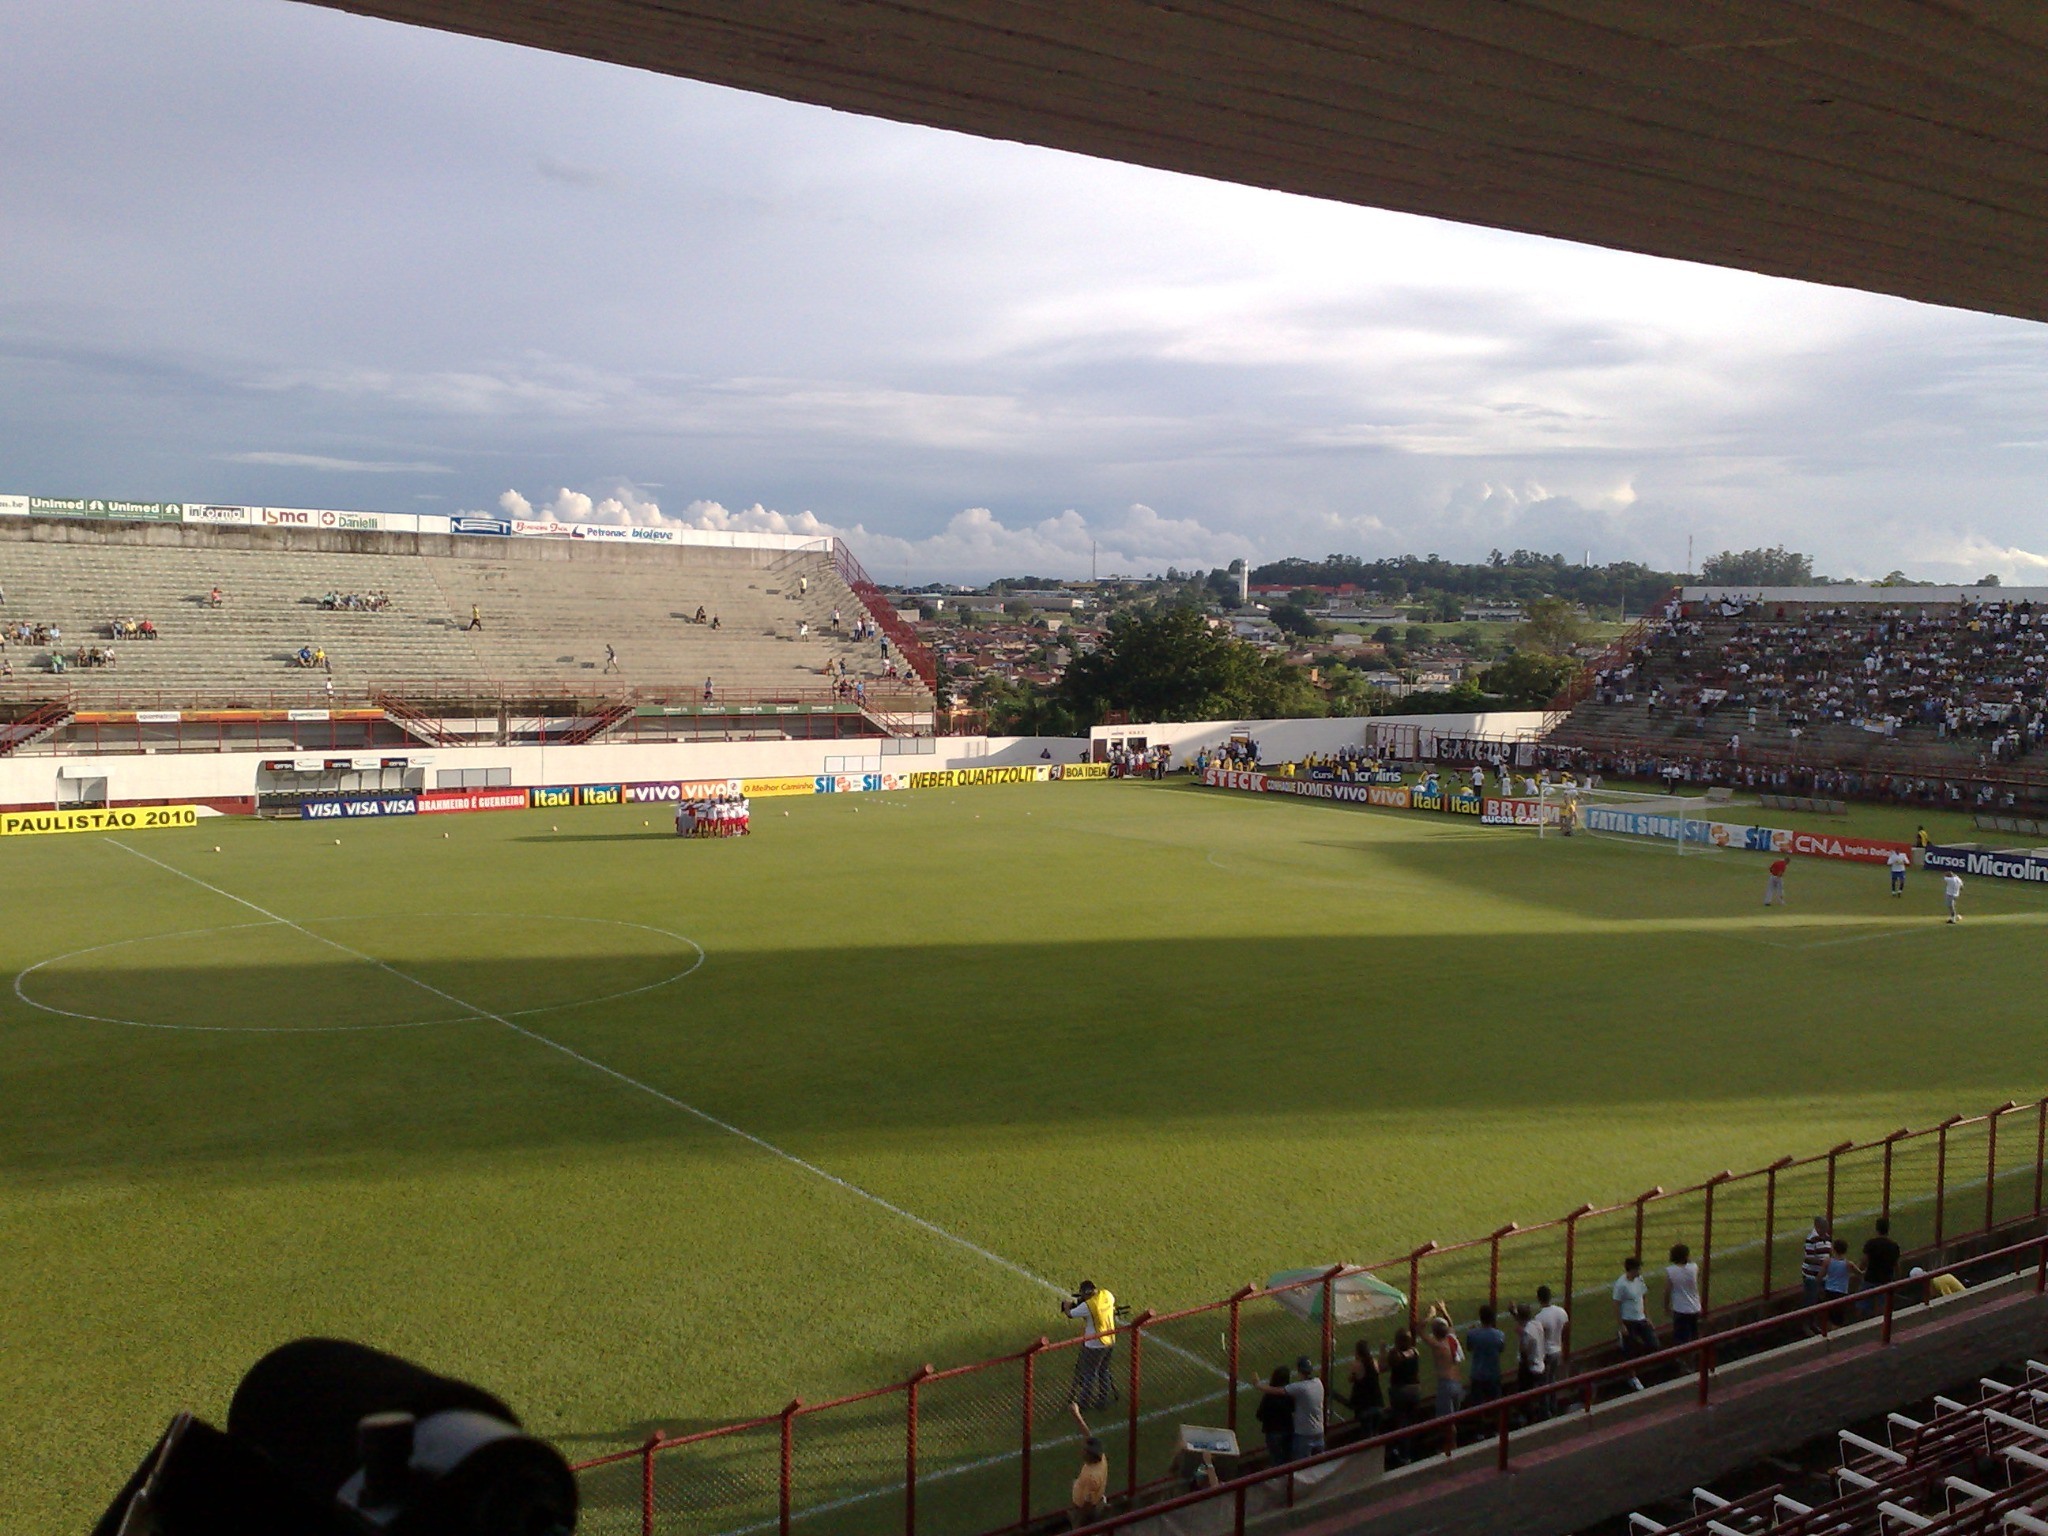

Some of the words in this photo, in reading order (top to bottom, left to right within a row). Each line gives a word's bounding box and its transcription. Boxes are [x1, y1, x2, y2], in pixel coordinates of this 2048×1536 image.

[31, 498, 84, 510] Unimed
[108, 501, 160, 513] Unimed
[909, 770, 954, 789] WEBER
[957, 766, 1037, 786] QUARTZOLIT
[1066, 767, 1084, 778] BOA
[1206, 770, 1263, 791] STECK
[781, 782, 814, 790] Caminho
[815, 777, 835, 793] Sil
[863, 774, 882, 791] Sil
[1297, 781, 1333, 798] DOMUS
[534, 788, 570, 807] Itaú
[583, 786, 618, 804] Itaú
[636, 785, 680, 801] VIVO
[685, 784, 727, 799] VIVO
[1333, 785, 1368, 802] VIVO
[1370, 788, 1406, 806] VIVO
[304, 803, 341, 817] VISA
[343, 801, 380, 815] VISA
[381, 799, 416, 814] VISA
[418, 798, 469, 811] BRAHMEIRO
[471, 796, 478, 809] É
[478, 795, 525, 808] GUERREIRO
[1413, 792, 1441, 810] Itaú
[1451, 796, 1480, 814] Itaú
[7, 811, 136, 832] PAULISTÃO
[145, 810, 195, 825] 2010
[1590, 810, 1634, 833] FATAL
[1795, 835, 1844, 857] CNA
[1925, 852, 1966, 868] Cursos
